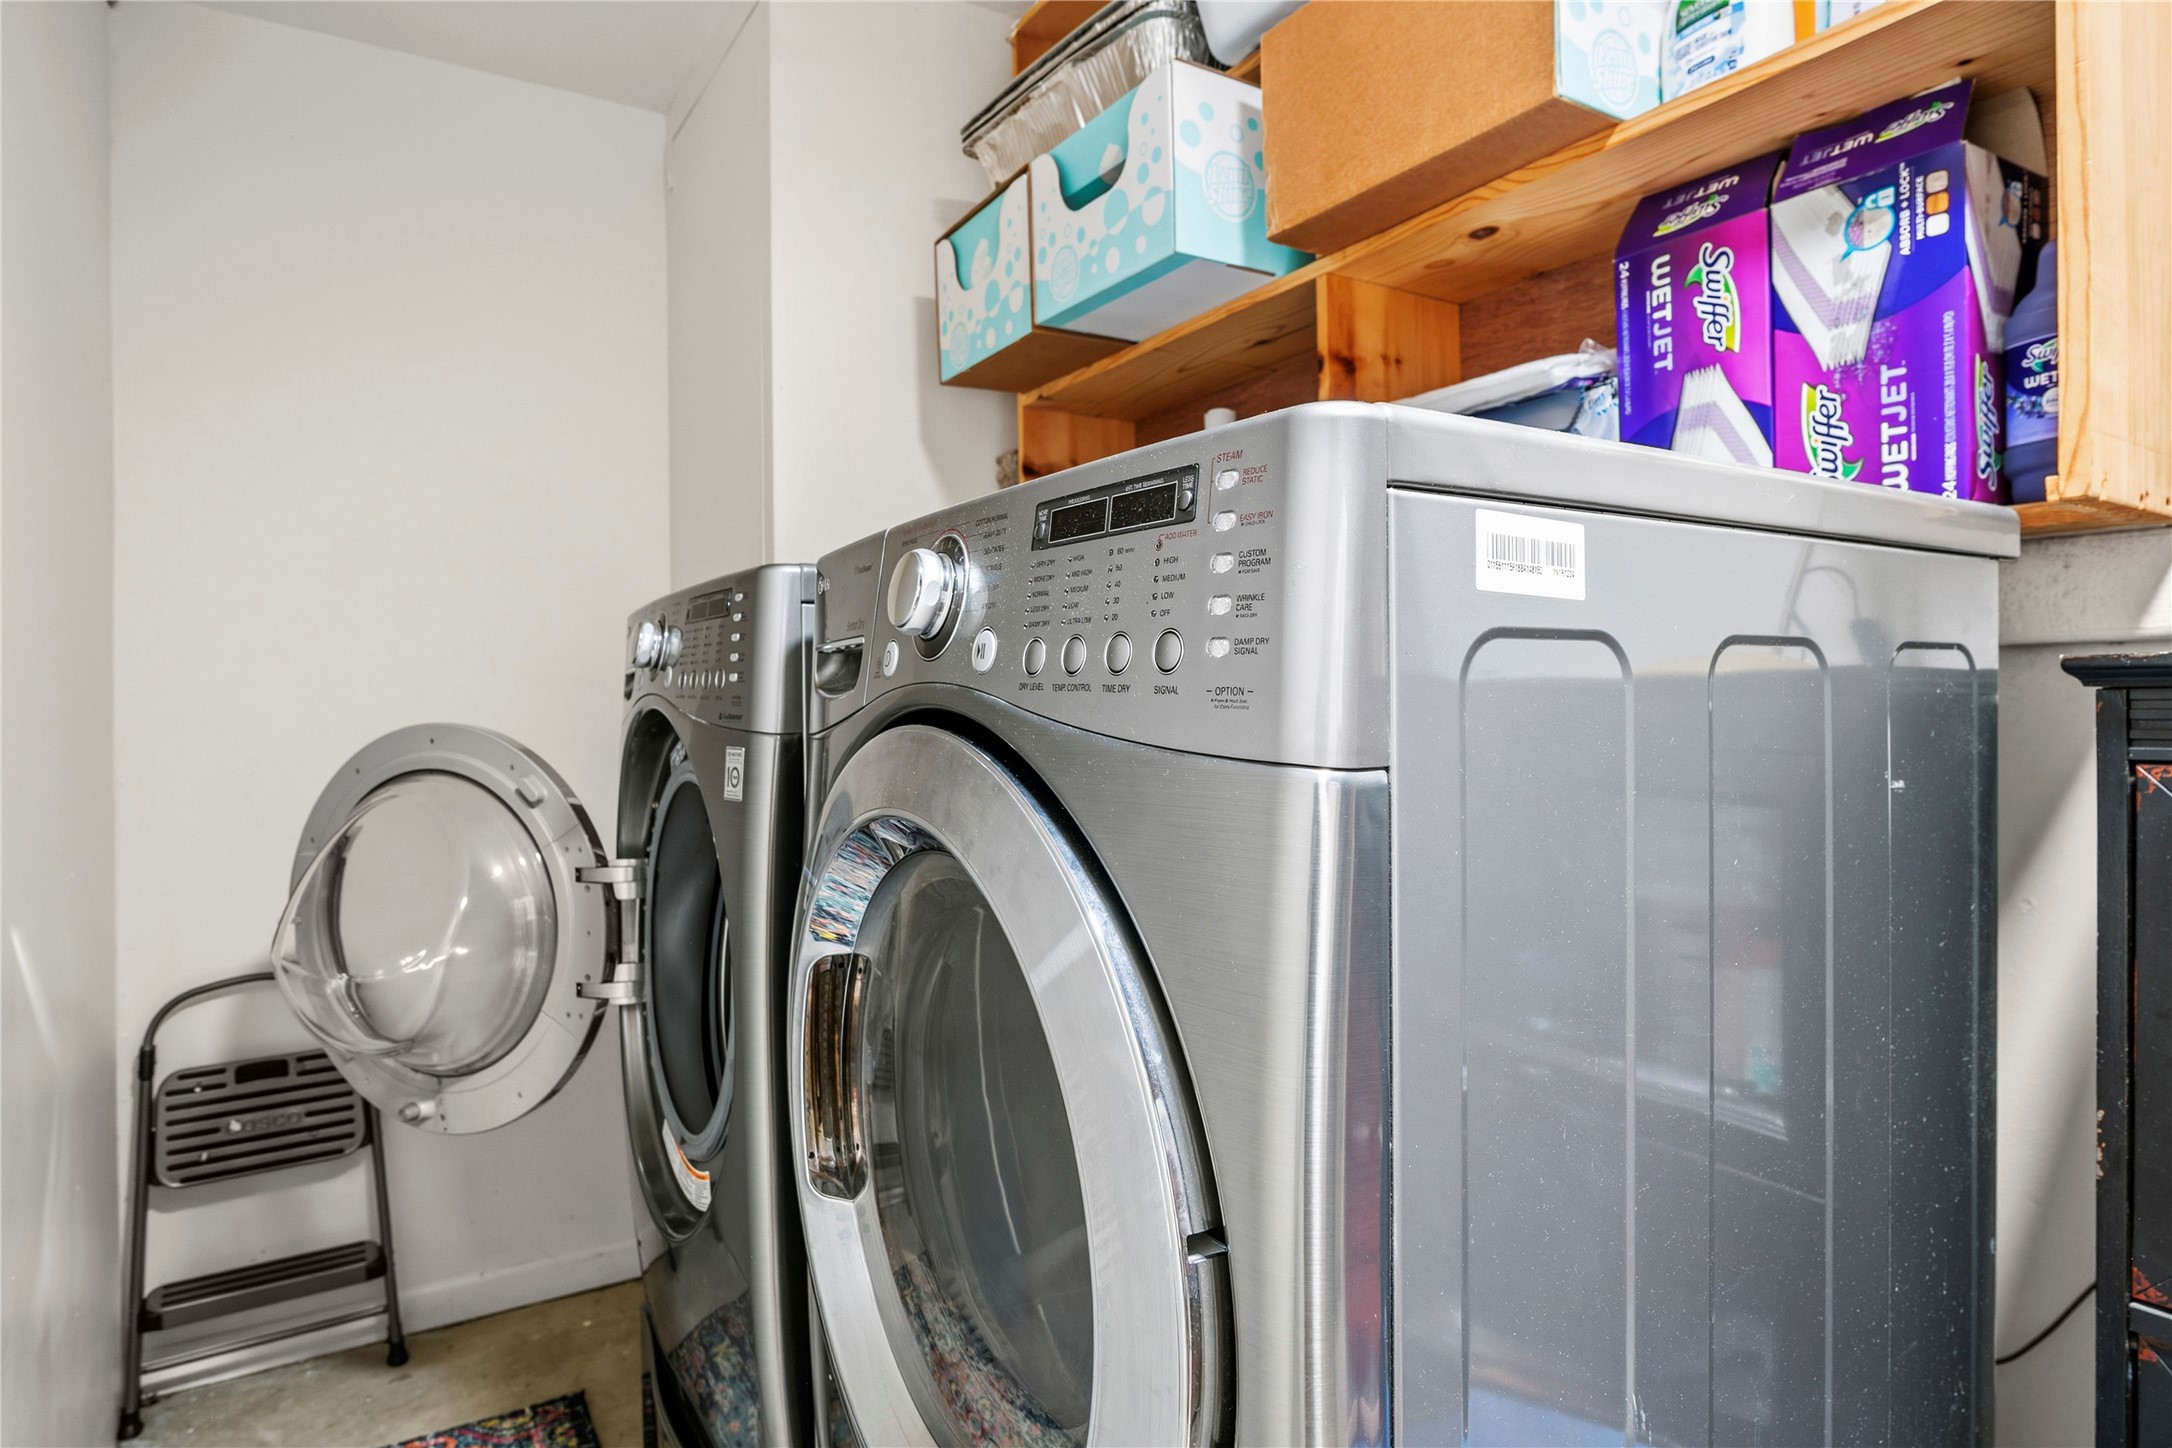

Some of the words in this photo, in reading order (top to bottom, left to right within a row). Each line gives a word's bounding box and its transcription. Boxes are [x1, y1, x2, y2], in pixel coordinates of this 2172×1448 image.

[1662, 174, 1740, 210] WETJET
[1692, 242, 1737, 353] Swiffer
[1650, 254, 1673, 371] WETJET
[1880, 365, 1909, 491] WETJET
[1977, 358, 2000, 492] Swiffer
[1804, 384, 1854, 480] wiffer
[1216, 450, 1244, 463] STEAM
[1242, 464, 1268, 476] REDUCE
[1242, 475, 1264, 485] STATIC
[1239, 512, 1256, 522] EASY
[1257, 510, 1274, 520] IRON
[1238, 549, 1267, 559] CUSTOM
[1163, 556, 1178, 564] HIGH
[1238, 558, 1271, 567] PROGRAM
[1162, 573, 1186, 582] MEDIUM
[1160, 592, 1174, 600] LOW
[1236, 593, 1265, 603] WRINKLE
[1235, 603, 1252, 611] CARE
[1111, 613, 1119, 621] 20
[1159, 609, 1171, 617] OFF
[1234, 638, 1254, 646] DAMP
[1255, 637, 1270, 645] DRY
[1234, 647, 1259, 655] SIGNAL
[1029, 682, 1044, 691] LEVEL
[1101, 684, 1116, 693] TIME
[1117, 684, 1131, 693] DRY
[1153, 685, 1179, 695] SIGNAL
[1214, 686, 1245, 696] OPTION
